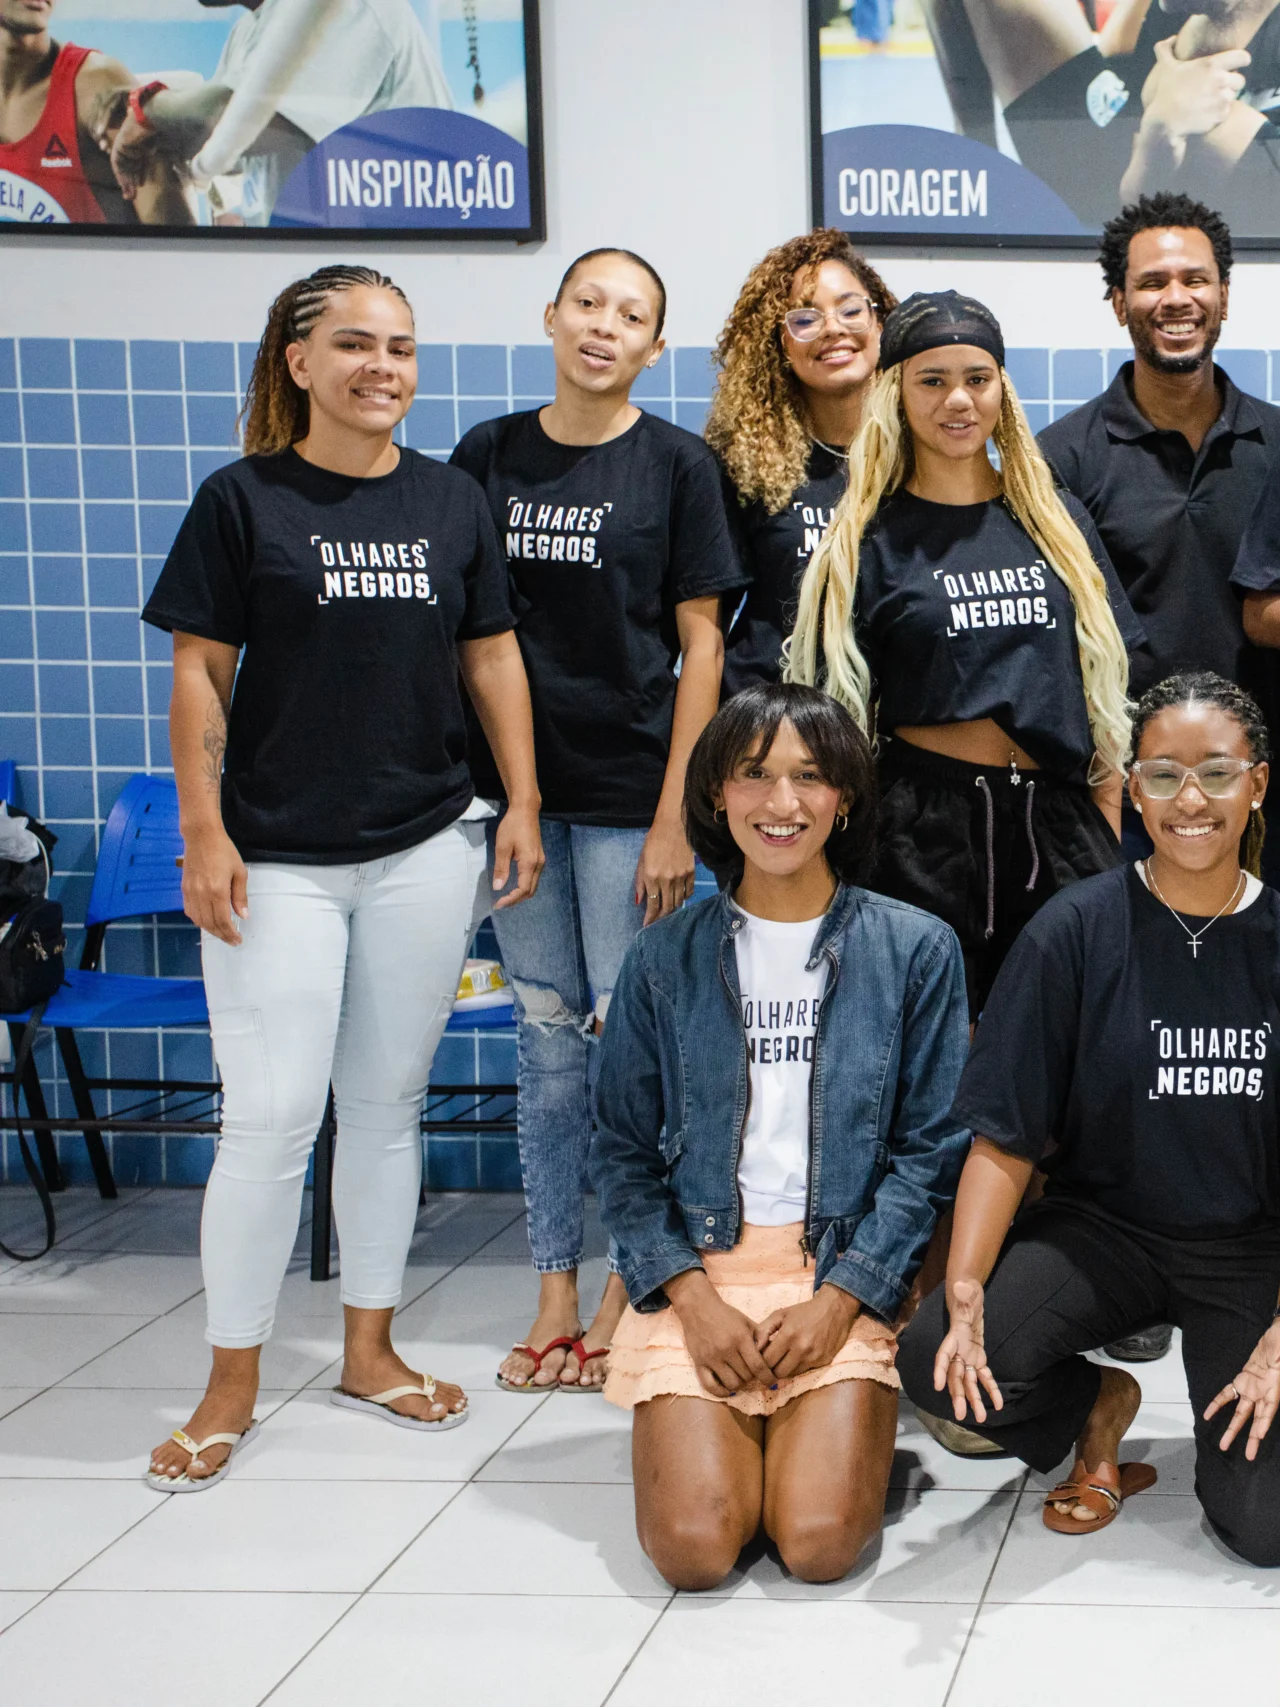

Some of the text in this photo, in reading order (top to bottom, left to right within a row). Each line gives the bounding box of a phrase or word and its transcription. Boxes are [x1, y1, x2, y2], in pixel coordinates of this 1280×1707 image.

[327, 154, 515, 219] INSPIRAÇÃO
[839, 168, 988, 217] CORAGEM
[509, 502, 604, 532] OLHARES
[320, 541, 427, 569] OLHARES
[506, 532, 596, 563] NEGROS
[324, 571, 431, 599] NEGROS
[943, 566, 1046, 598] OLHARES
[950, 597, 1049, 631] NEGROS
[1159, 1027, 1267, 1060] OLHARES
[1157, 1066, 1263, 1096] NEGROS
